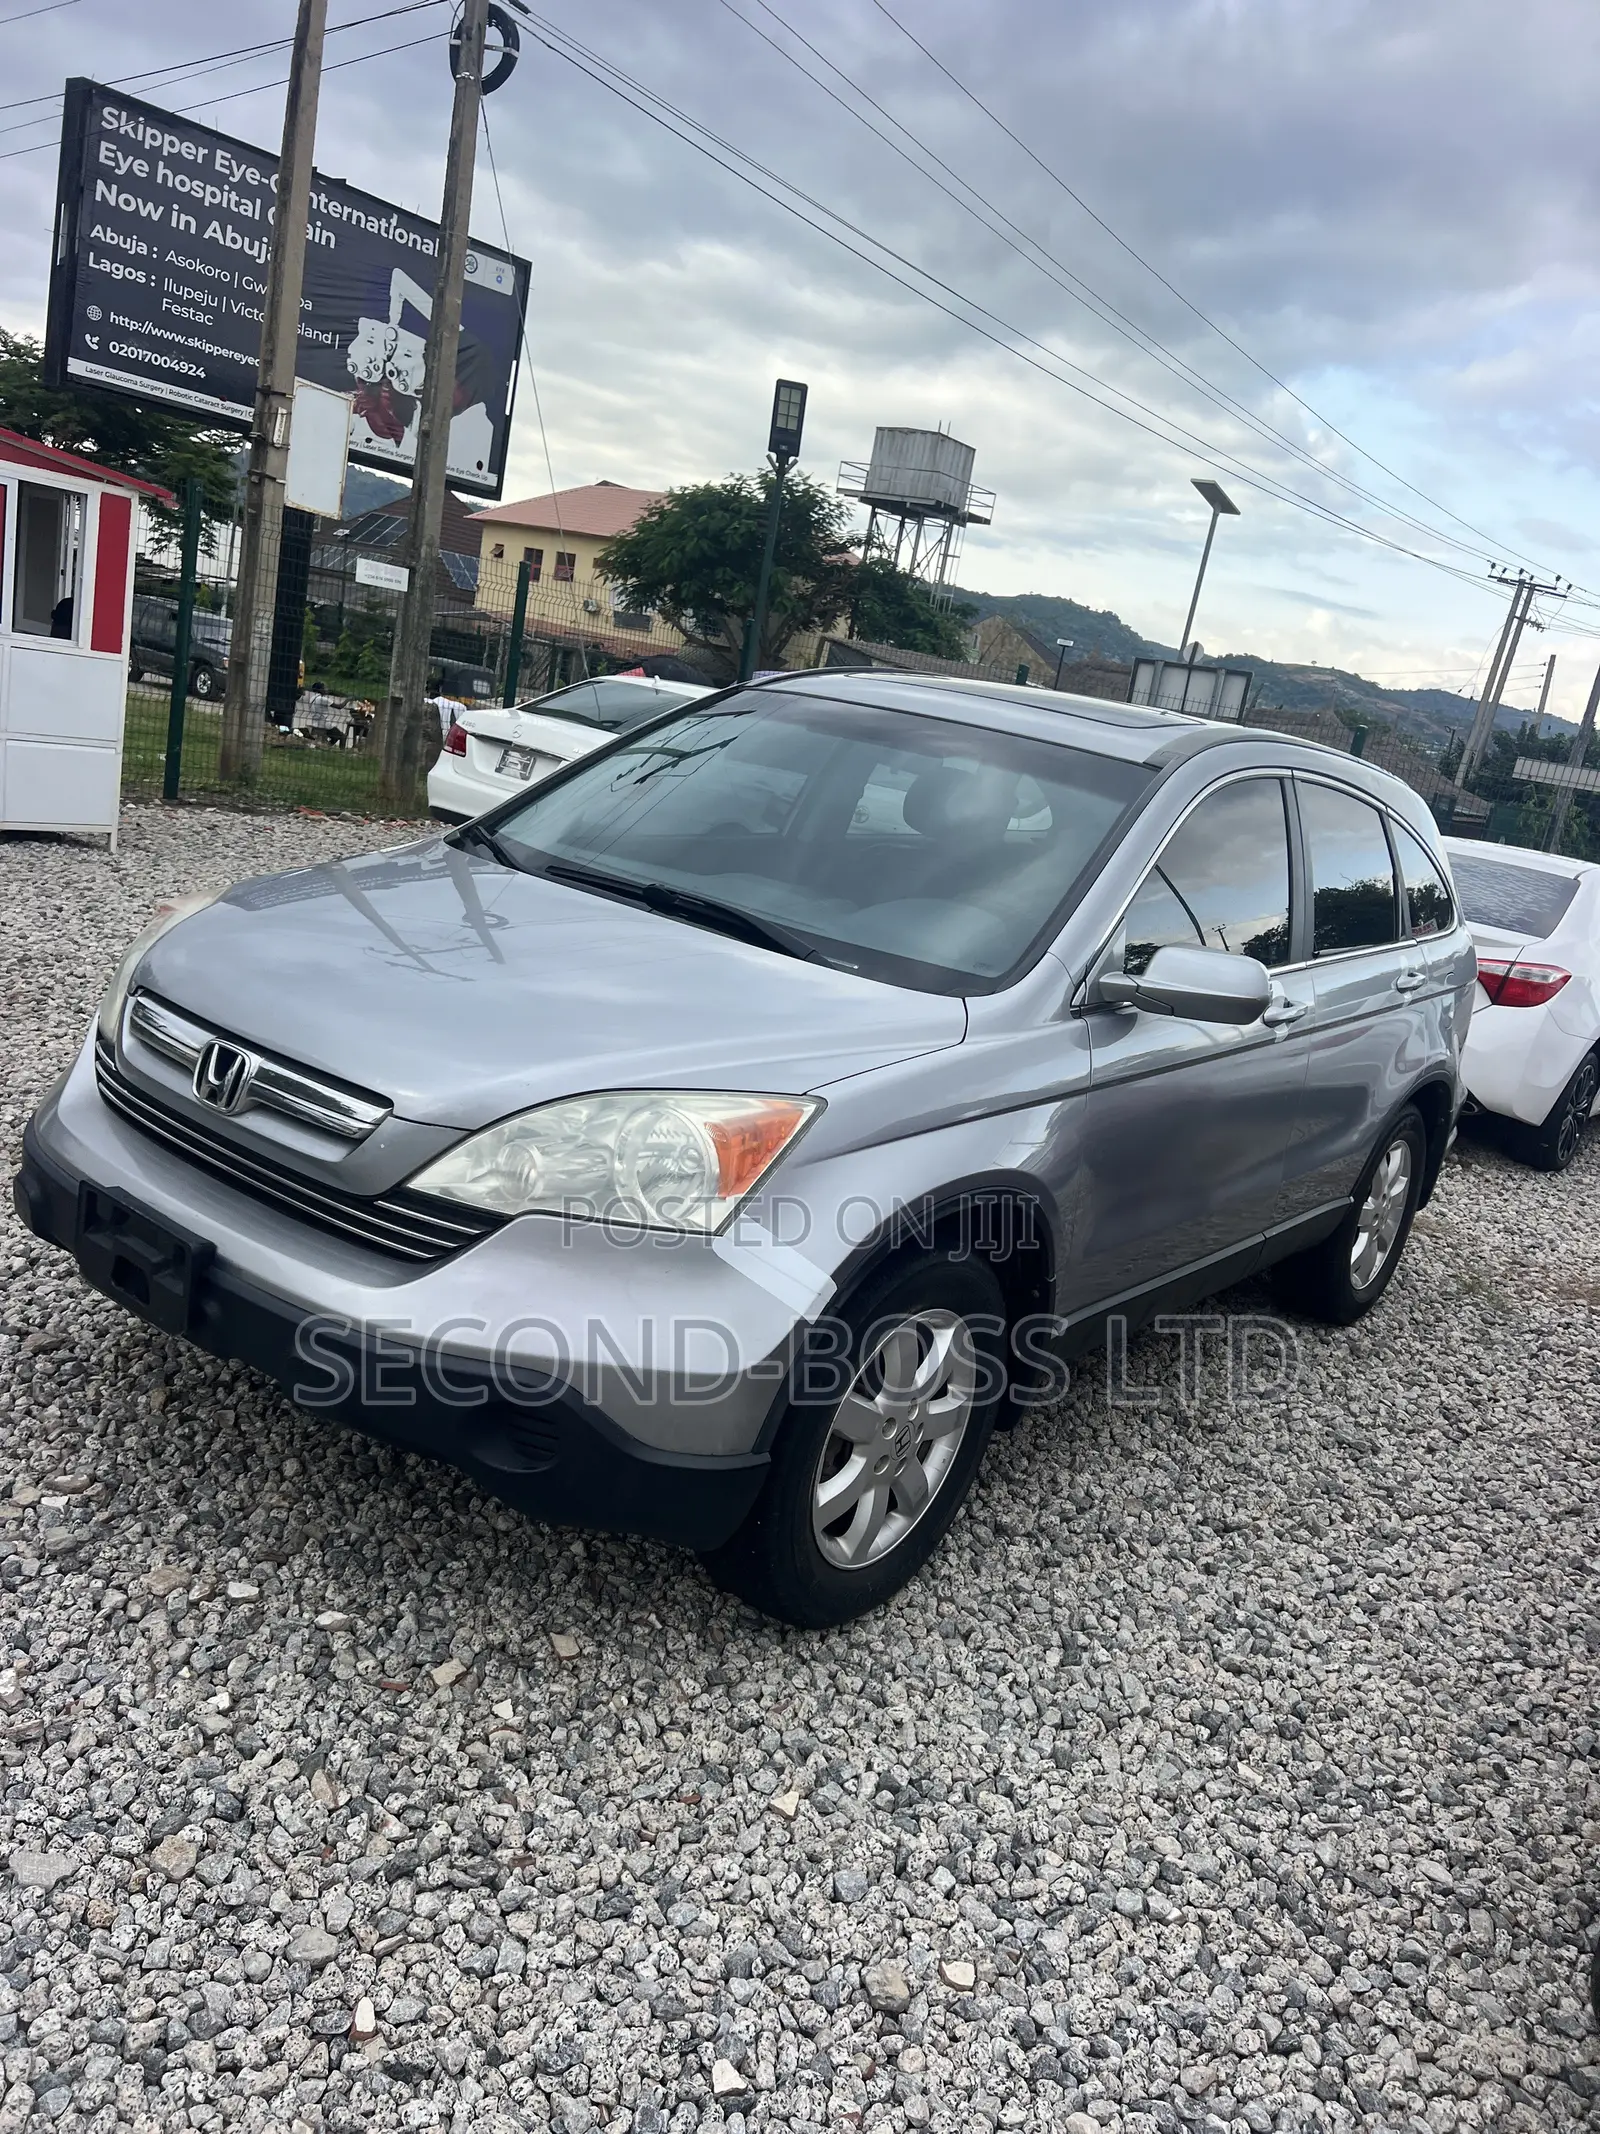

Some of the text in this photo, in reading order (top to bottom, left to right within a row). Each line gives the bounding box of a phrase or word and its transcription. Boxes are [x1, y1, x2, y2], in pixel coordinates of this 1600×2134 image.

[98, 140, 149, 178] Eye
[156, 160, 262, 221] hospital
[101, 106, 209, 164] Skipper
[308, 190, 440, 258] nternational
[95, 178, 272, 264] Now in Abuj
[164, 250, 230, 282] Asokoro
[162, 297, 214, 326] Festac
[163, 277, 218, 307] Ilupeju
[296, 322, 332, 345] sland
[108, 341, 206, 379] 02017004924
[85, 365, 104, 376] Laser
[104, 371, 138, 386] Glaucoma
[138, 380, 164, 394] Surgery
[168, 388, 193, 401] Robotic
[220, 403, 244, 416] Surgery
